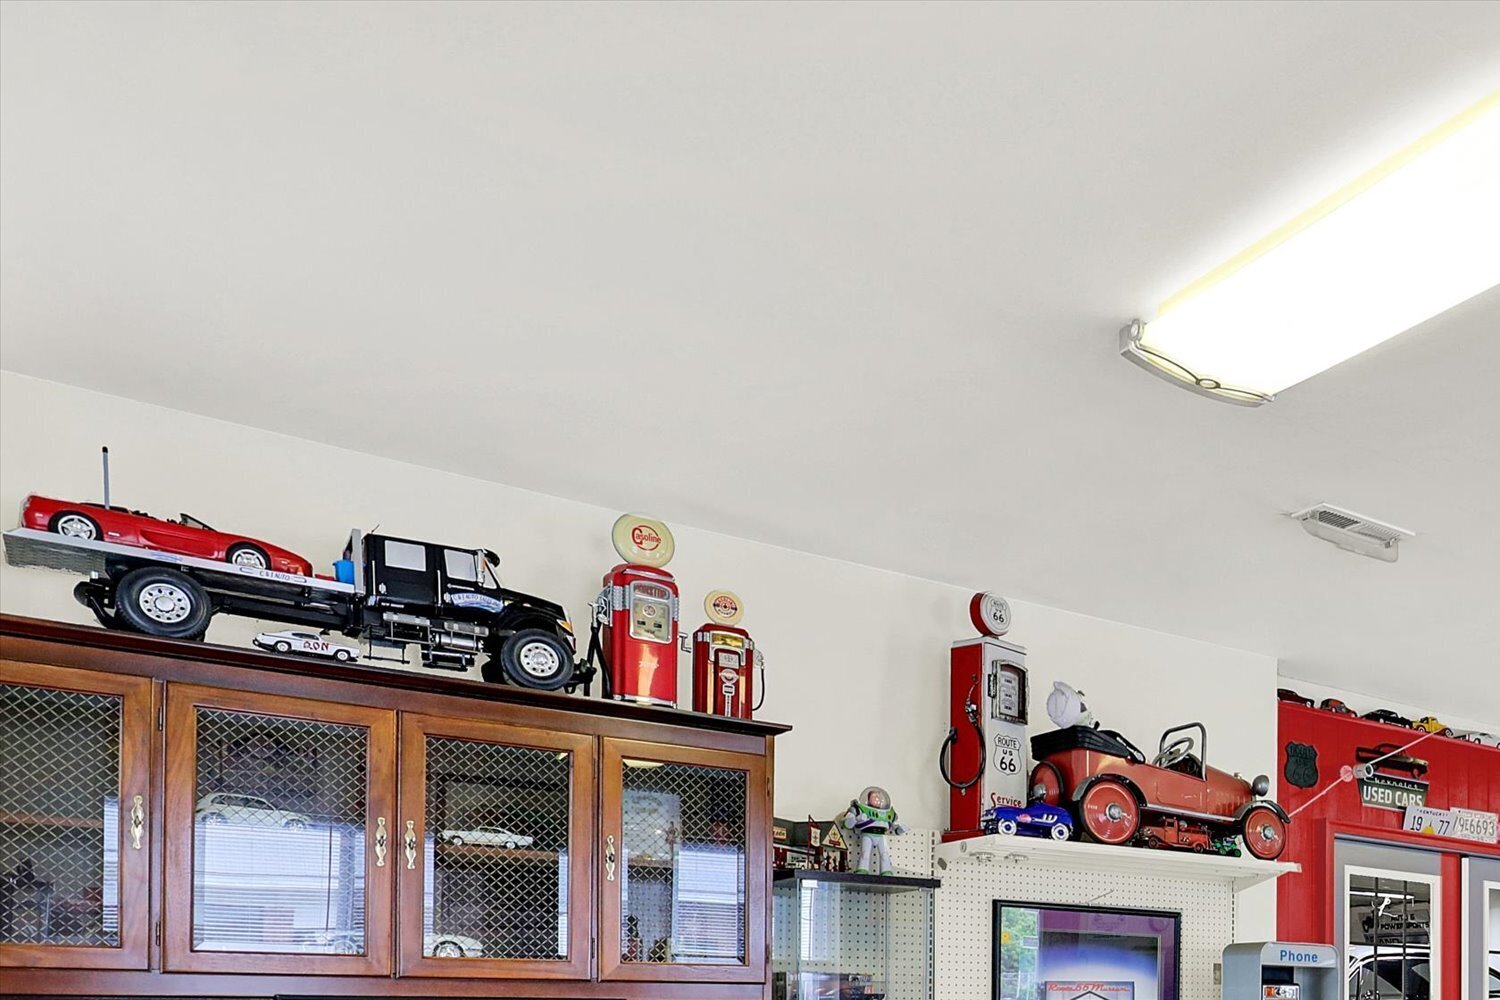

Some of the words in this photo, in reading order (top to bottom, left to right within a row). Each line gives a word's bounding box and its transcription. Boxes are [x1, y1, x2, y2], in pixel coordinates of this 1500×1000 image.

[631, 526, 661, 546] Gasoline
[993, 612, 1005, 623] 66
[997, 737, 1017, 749] ROUTE
[999, 758, 1017, 772] 66
[991, 792, 1022, 808] Service
[1363, 785, 1393, 804] USED
[1395, 791, 1423, 808] CARS
[1410, 815, 1424, 832] 19
[1438, 820, 1451, 835] 77
[1279, 949, 1319, 963] Phone
